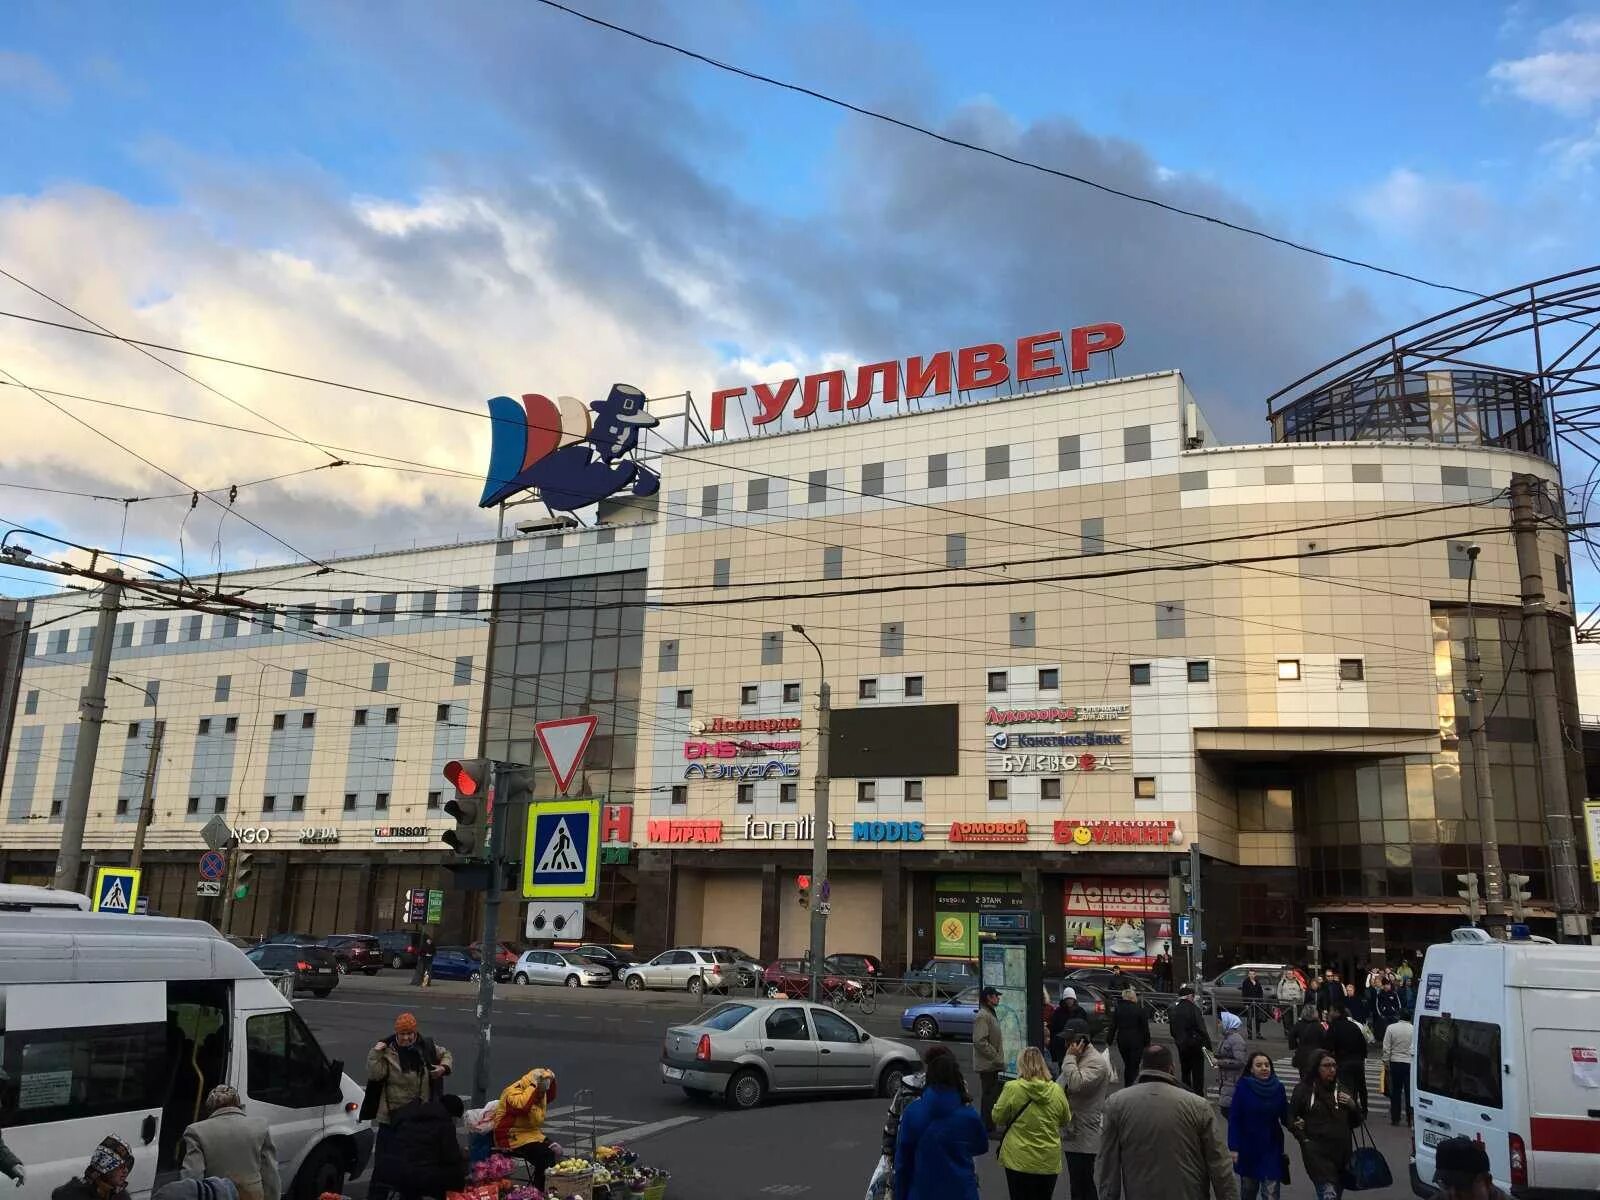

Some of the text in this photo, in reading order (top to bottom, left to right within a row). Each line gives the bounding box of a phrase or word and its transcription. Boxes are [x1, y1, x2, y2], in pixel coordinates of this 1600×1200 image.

[710, 321, 1126, 431] ГУЛЛИВЕР
[685, 741, 737, 759] DNS
[390, 826, 428, 836] TISSOT
[852, 821, 925, 843] MODIS
[1067, 882, 1170, 910] ДОМОВО
